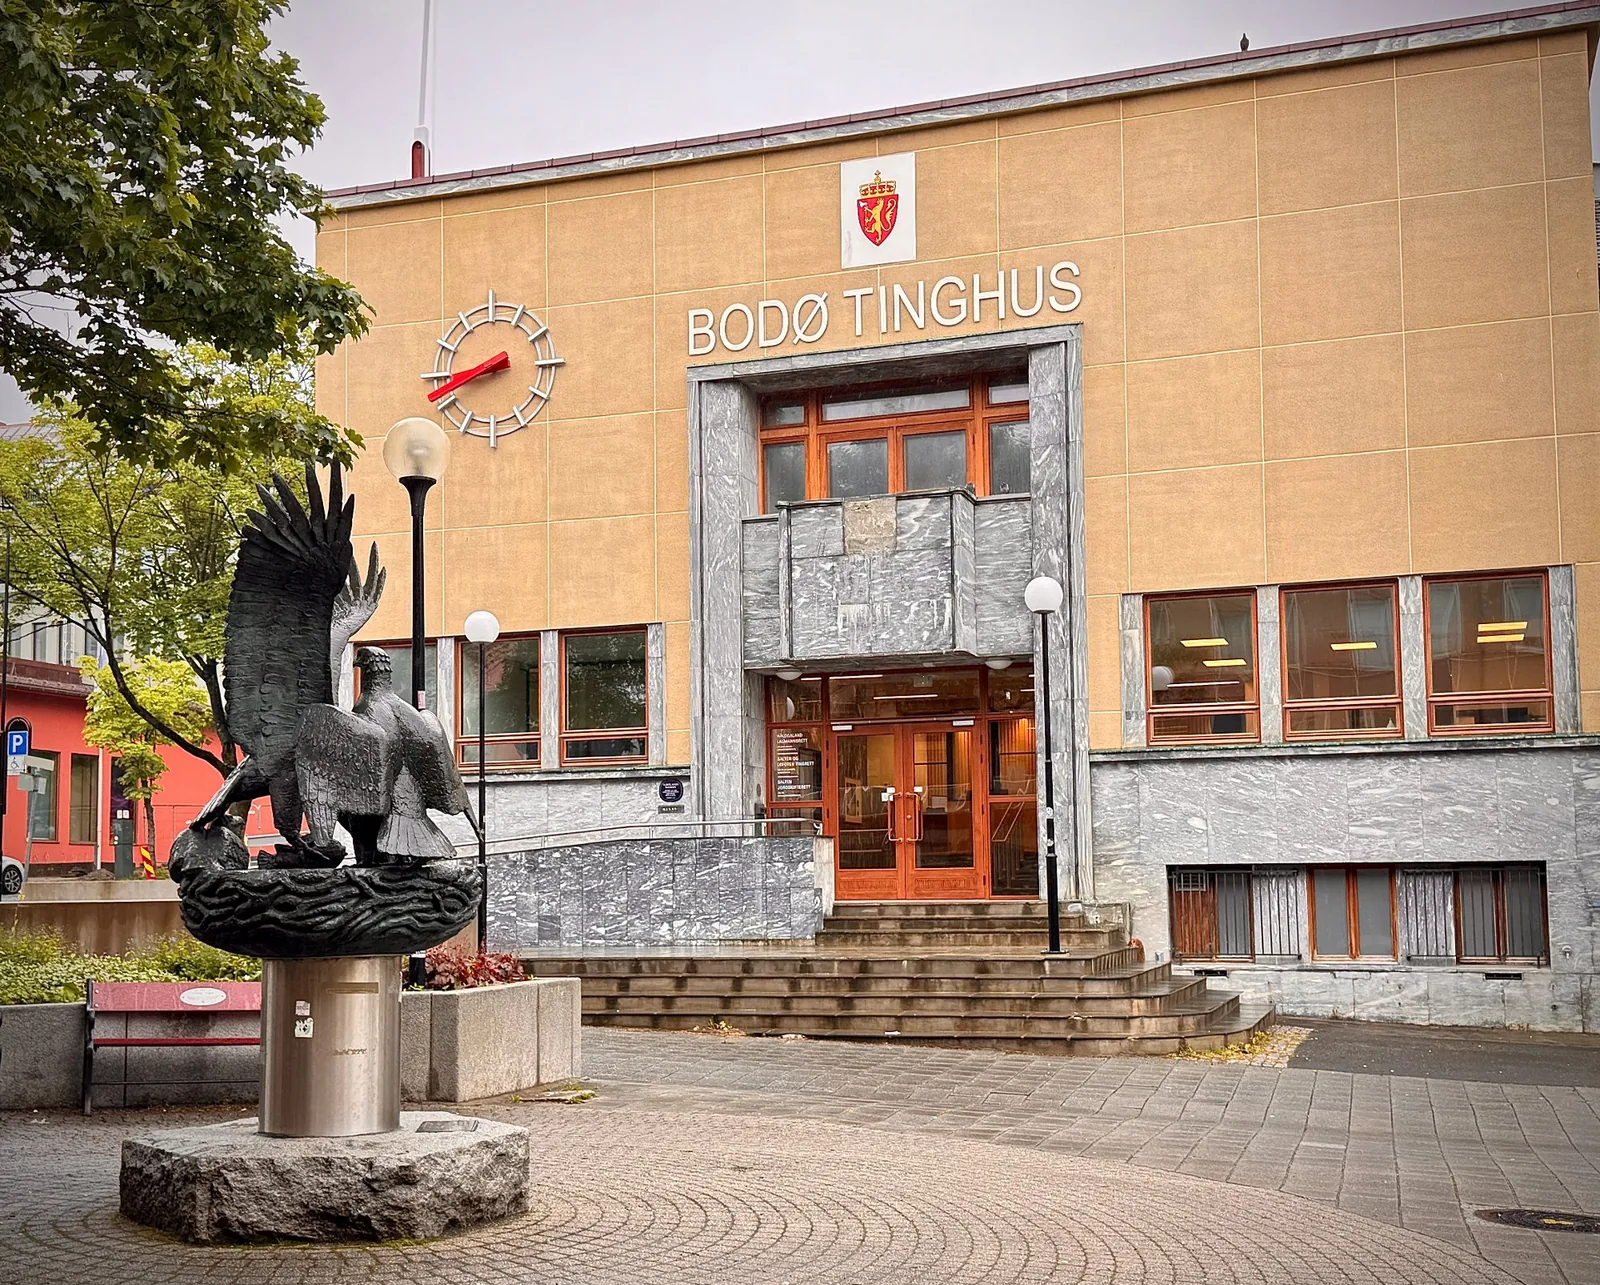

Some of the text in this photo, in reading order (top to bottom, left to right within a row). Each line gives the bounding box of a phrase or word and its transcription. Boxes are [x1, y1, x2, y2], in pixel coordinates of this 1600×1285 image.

[687, 261, 1082, 356] BODØ TINGHUS
[12, 734, 23, 752] P
